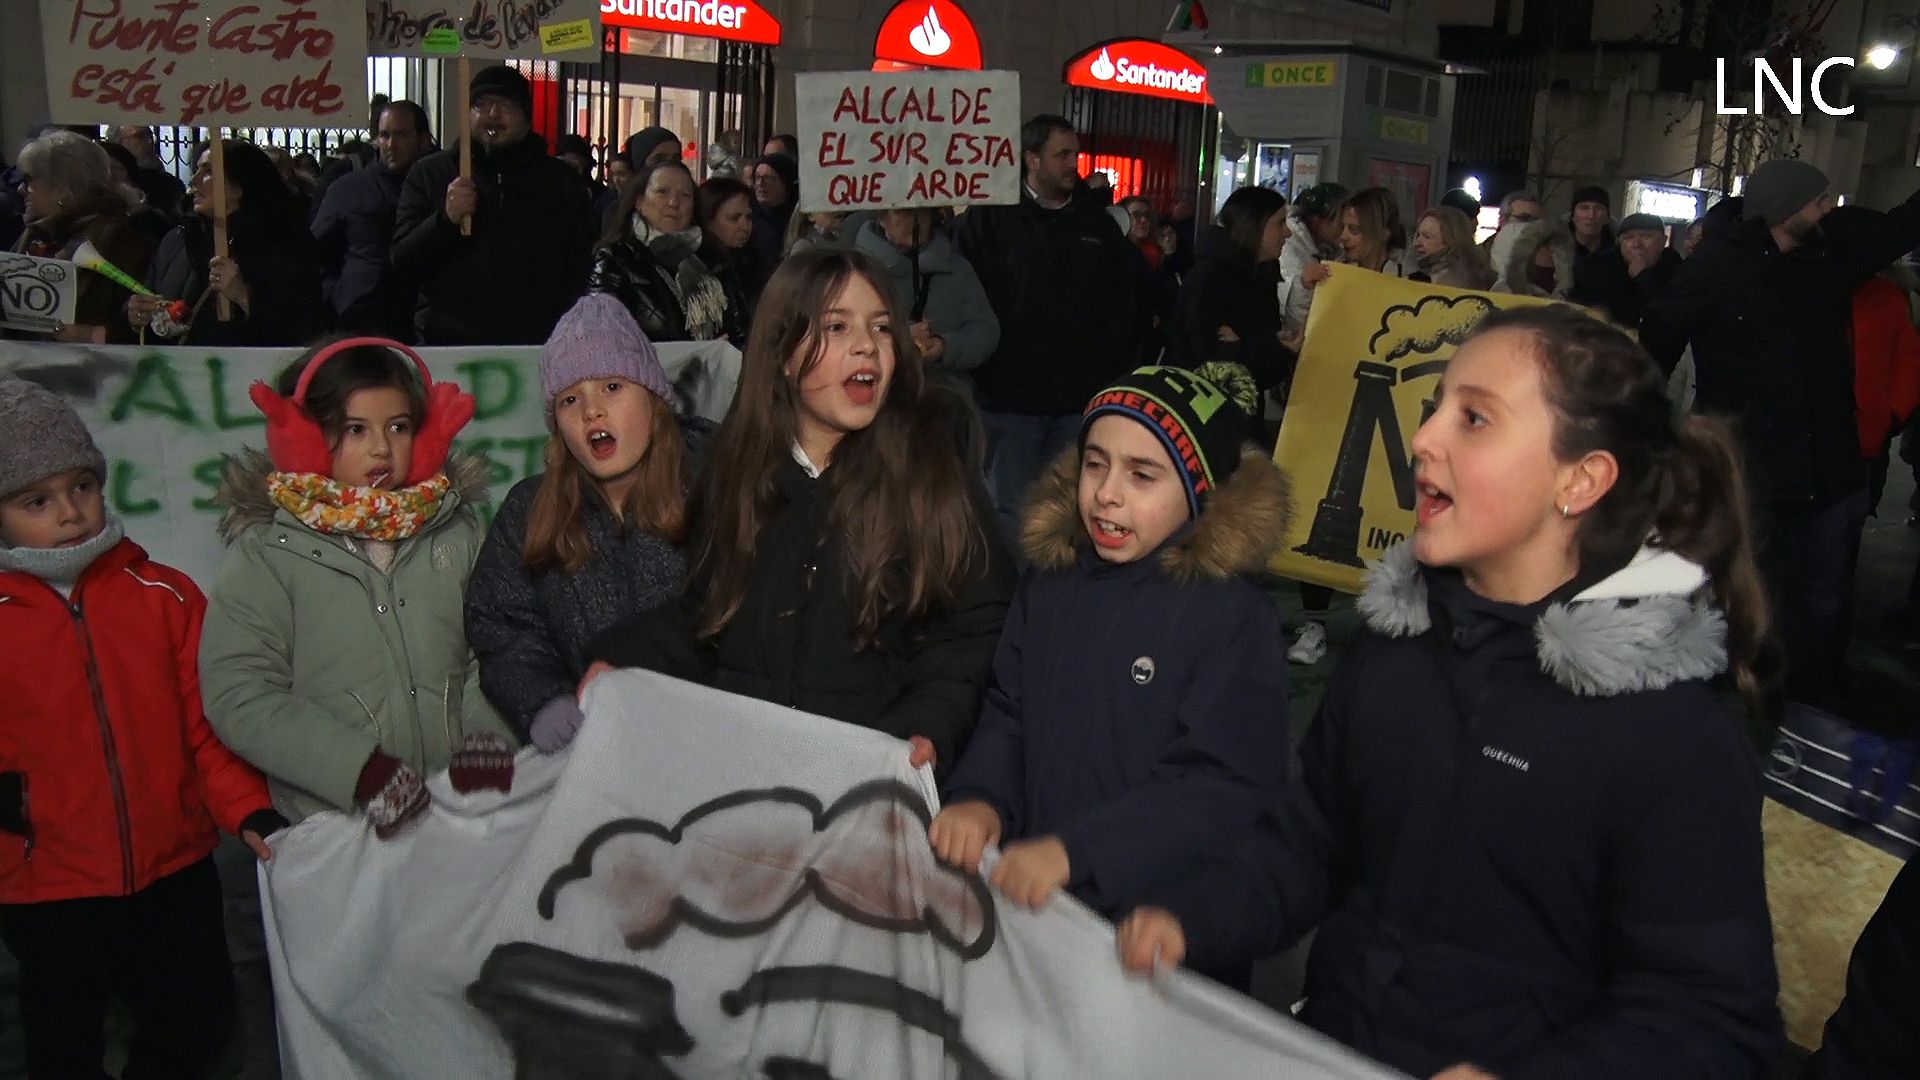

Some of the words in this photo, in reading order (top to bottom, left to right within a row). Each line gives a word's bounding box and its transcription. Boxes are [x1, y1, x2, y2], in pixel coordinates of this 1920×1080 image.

[70, 0, 199, 54] Puente
[207, 5, 335, 61] Castro
[72, 57, 177, 112] está
[181, 78, 251, 124] que
[260, 60, 345, 115] arde
[1116, 57, 1205, 93] Santander
[1272, 65, 1327, 83] ONCE
[833, 86, 992, 124] ALCALDE
[818, 132, 855, 167] EL
[869, 131, 929, 165] SUR
[945, 133, 1015, 167] ESTA
[828, 172, 886, 205] QUE
[906, 169, 990, 200] ARDE
